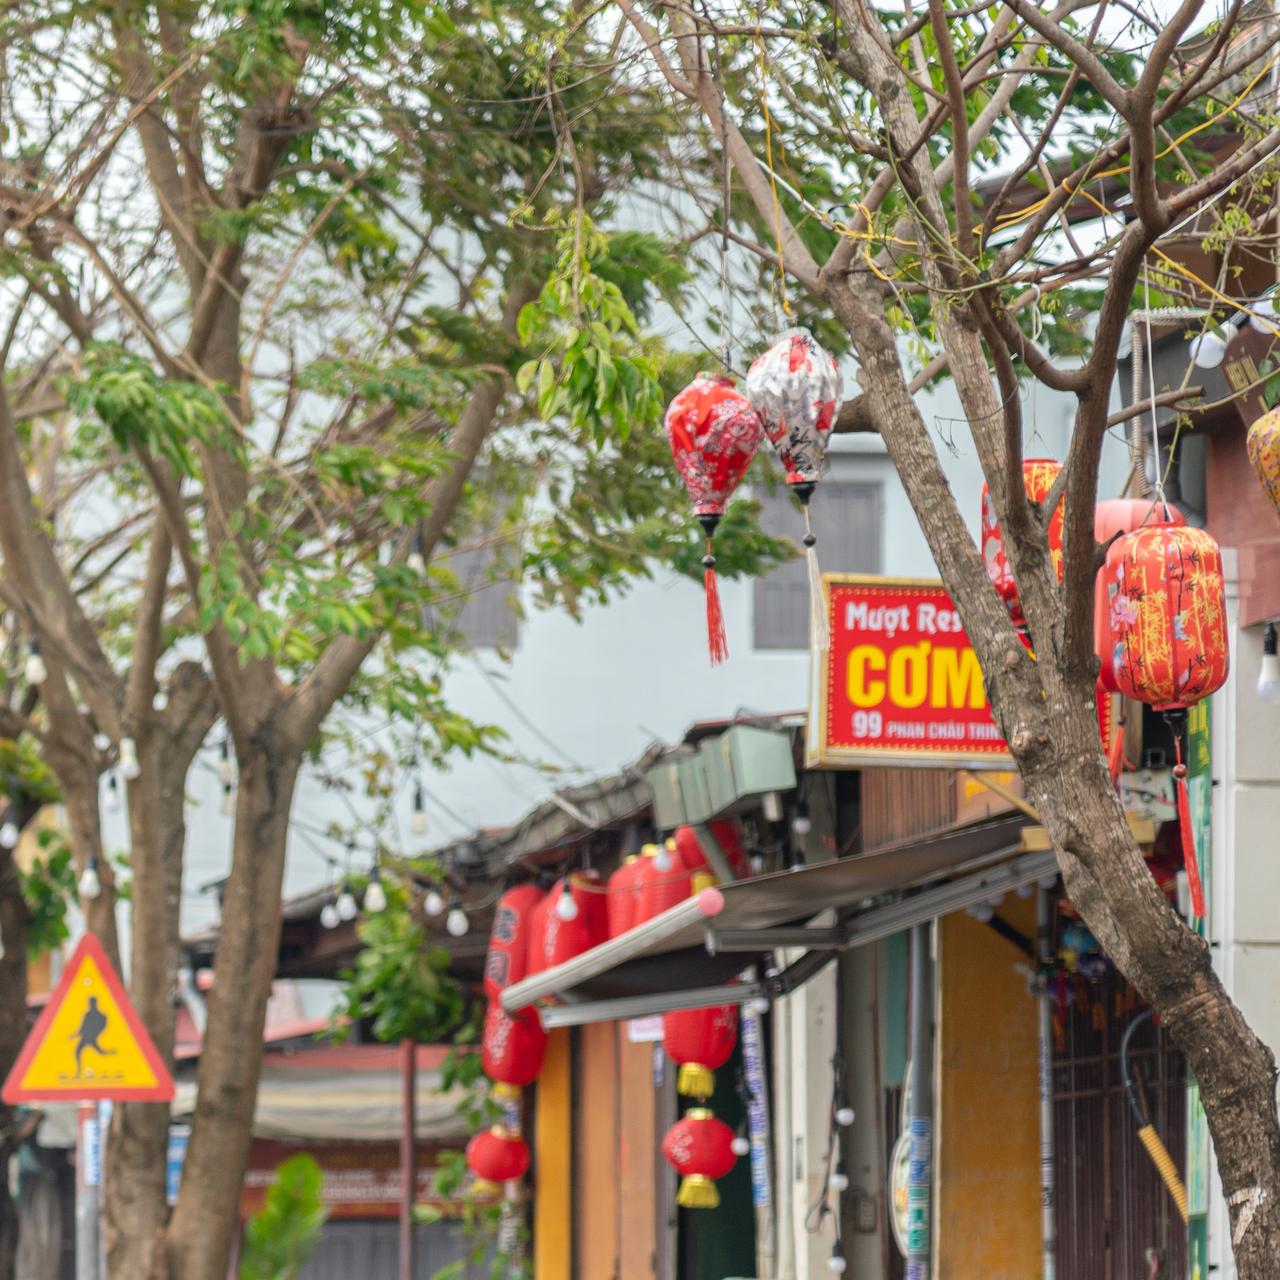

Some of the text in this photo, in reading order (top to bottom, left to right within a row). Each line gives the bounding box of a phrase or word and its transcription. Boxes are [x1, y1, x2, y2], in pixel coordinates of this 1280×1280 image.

[845, 602, 910, 638] Mượt
[847, 640, 986, 708] CƠM
[852, 710, 882, 738] 99
[887, 721, 925, 738] PHAN
[928, 719, 965, 739] CHÂU
